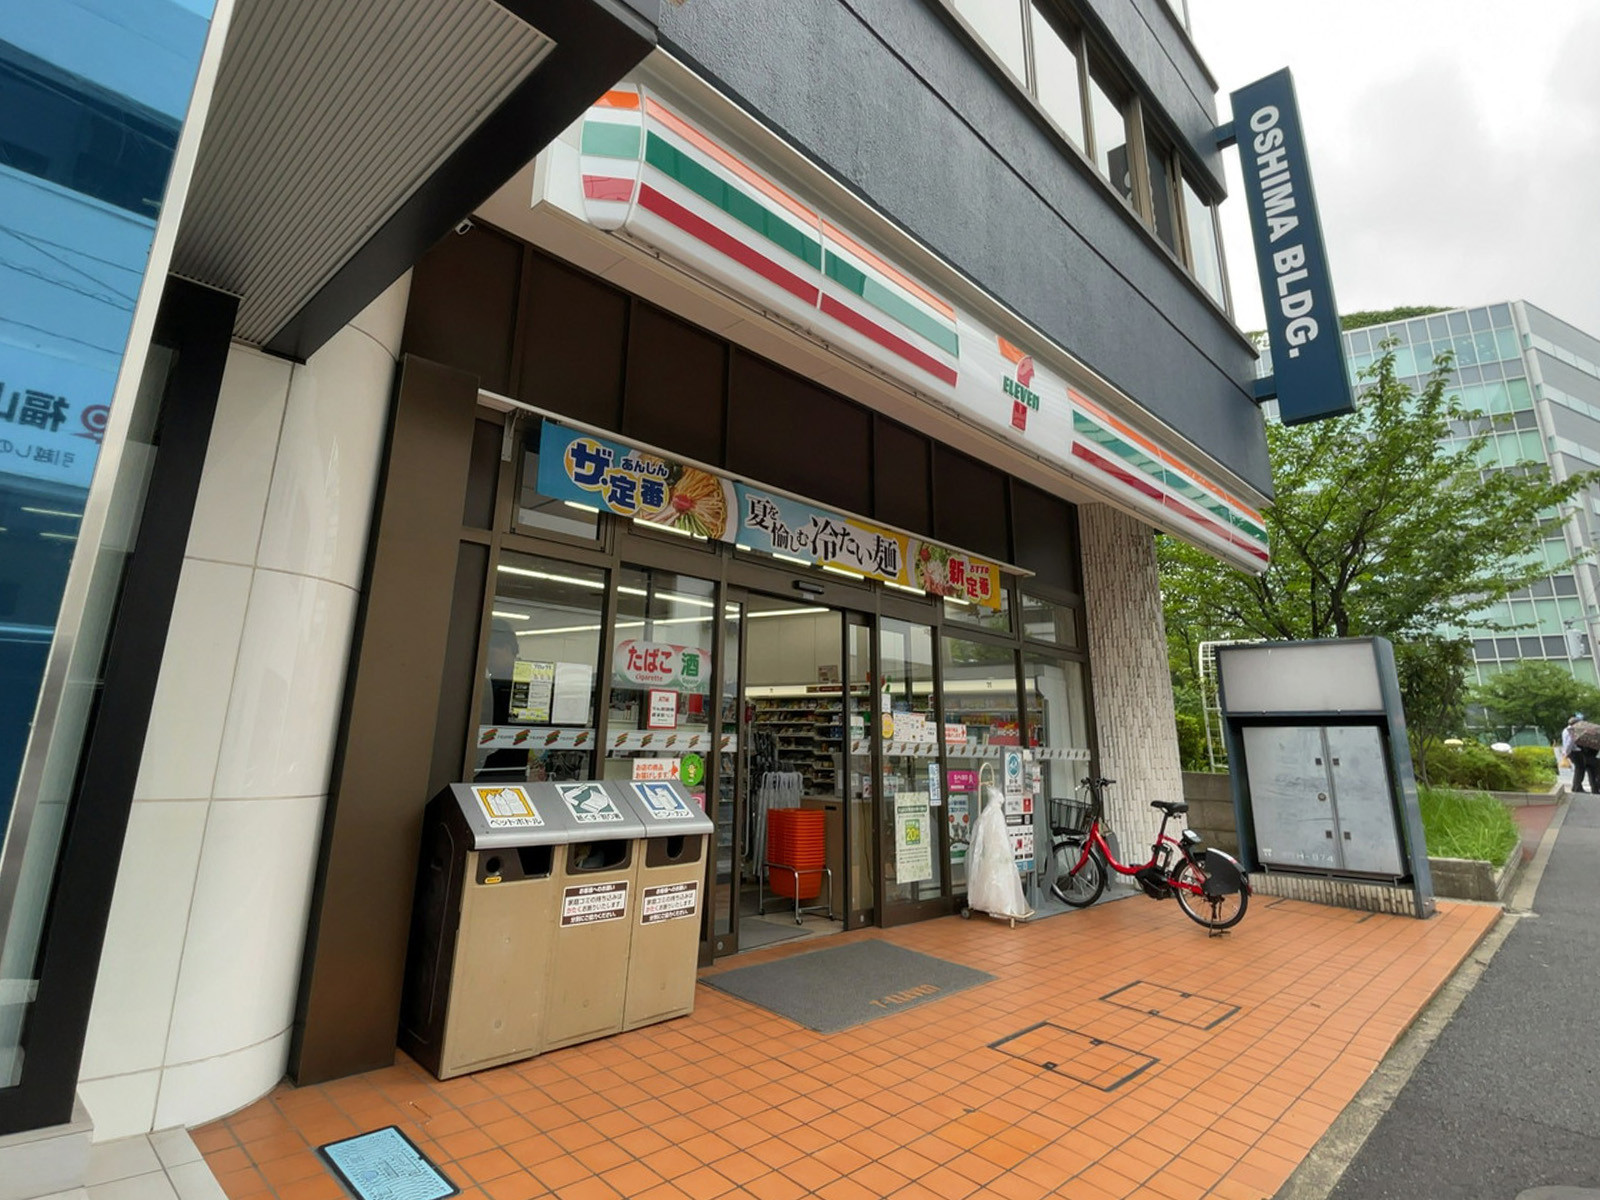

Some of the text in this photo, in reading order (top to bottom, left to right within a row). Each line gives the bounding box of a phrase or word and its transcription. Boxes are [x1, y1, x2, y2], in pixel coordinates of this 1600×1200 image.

[1250, 105, 1319, 358] OSHIMA BLDG.
[621, 458, 668, 477] あんしん
[627, 646, 673, 674] たばこ
[681, 652, 700, 677] 酒
